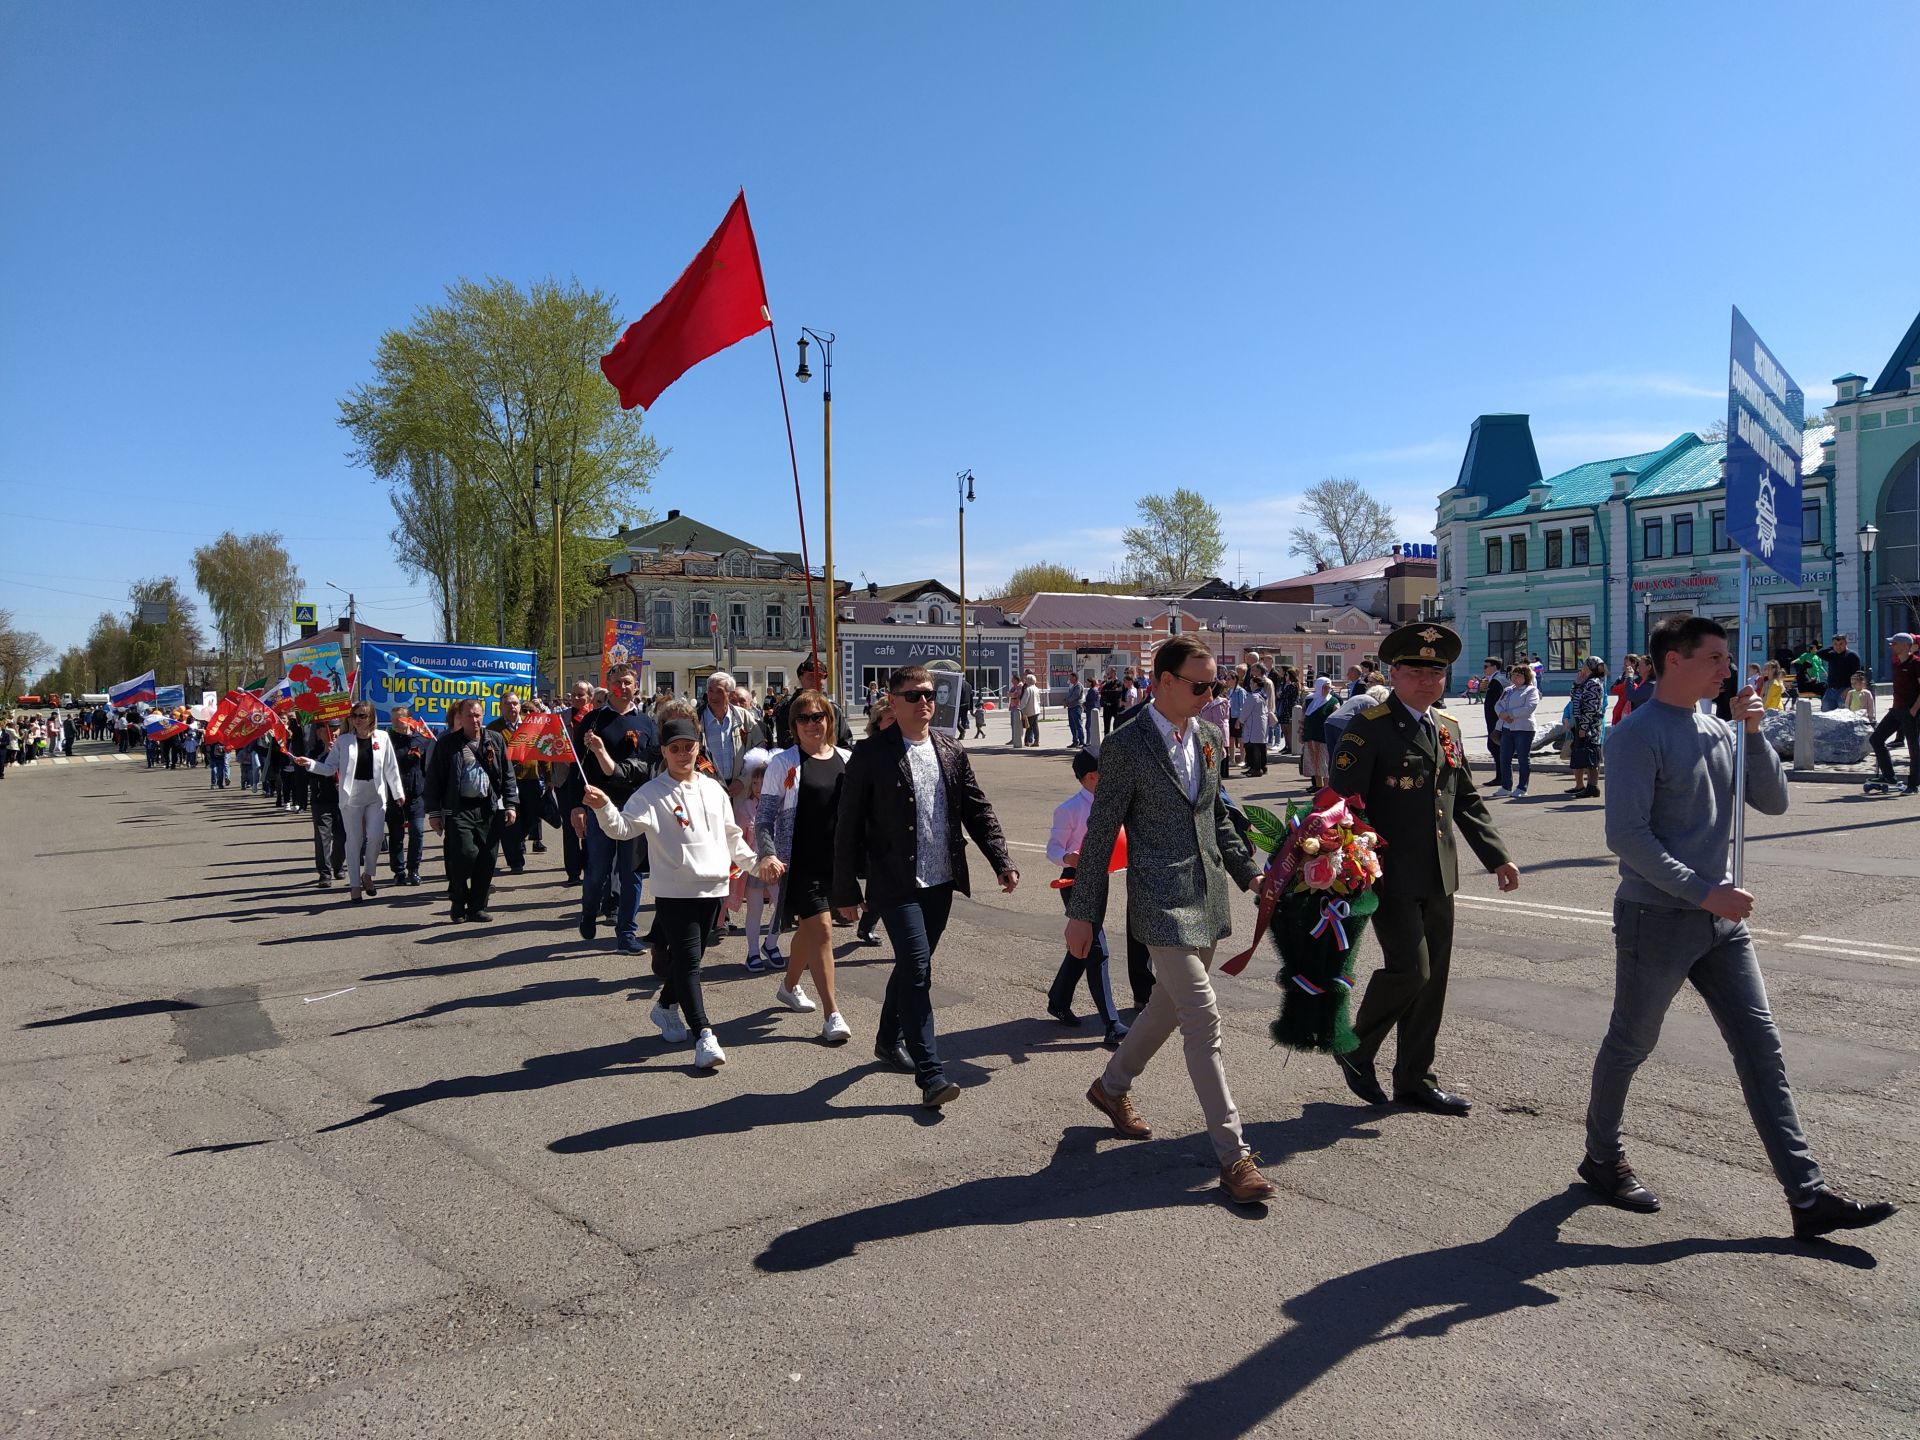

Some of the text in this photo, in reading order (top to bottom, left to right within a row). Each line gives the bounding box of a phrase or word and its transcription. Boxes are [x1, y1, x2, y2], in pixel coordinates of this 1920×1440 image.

[1730, 575, 1778, 587] LNGE
[874, 645, 896, 656] café
[411, 655, 447, 667] Филиал
[450, 657, 468, 667] ОАО
[381, 677, 532, 701] ЧИСТОПОЛЬСКИЙ
